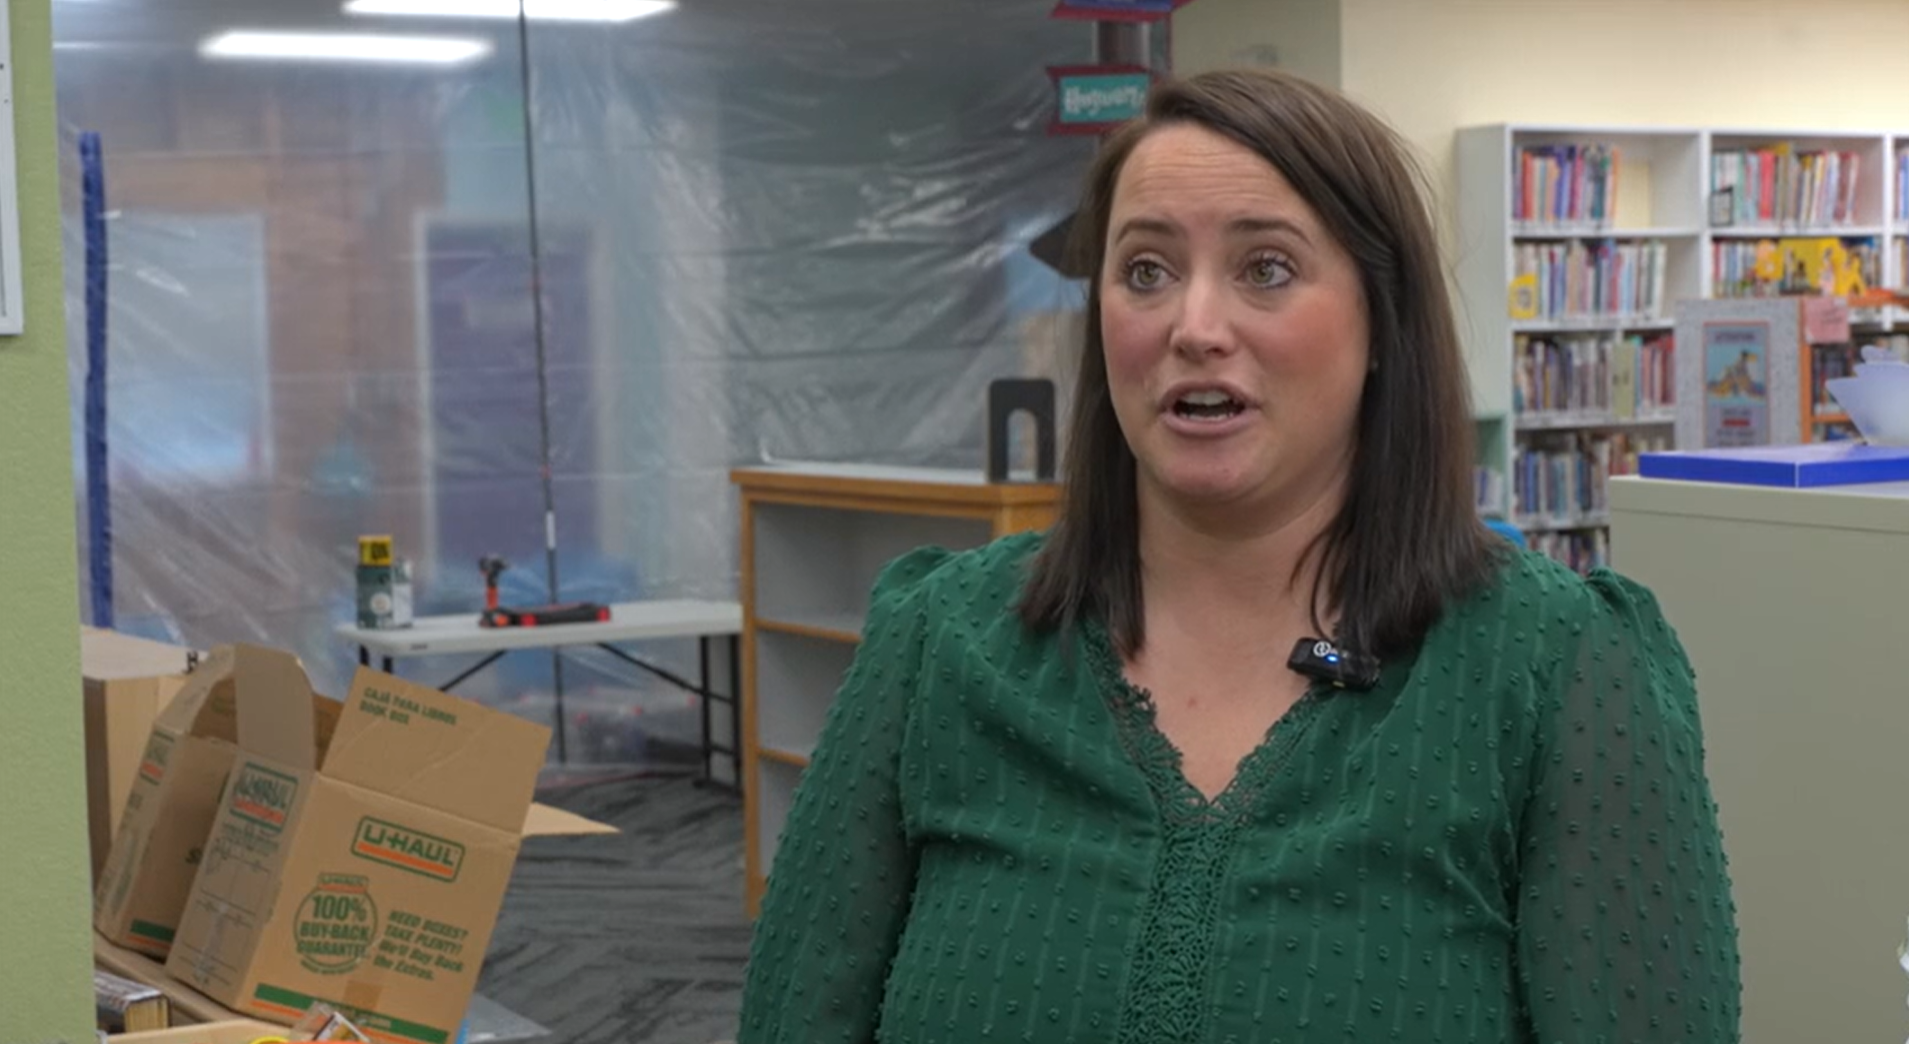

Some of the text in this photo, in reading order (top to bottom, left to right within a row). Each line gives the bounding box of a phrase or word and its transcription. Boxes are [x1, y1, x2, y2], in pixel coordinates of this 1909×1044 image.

[360, 699, 387, 717] BOOK
[363, 686, 390, 704] CAJA
[421, 705, 457, 726] LIBROS
[362, 823, 455, 867] U-HAUL
[313, 894, 367, 923] 100%
[388, 910, 421, 928] NEED
[300, 921, 370, 941] BUY-BACK
[384, 924, 414, 942] TAKE
[409, 947, 434, 966] Buy
[434, 955, 463, 973] Back
